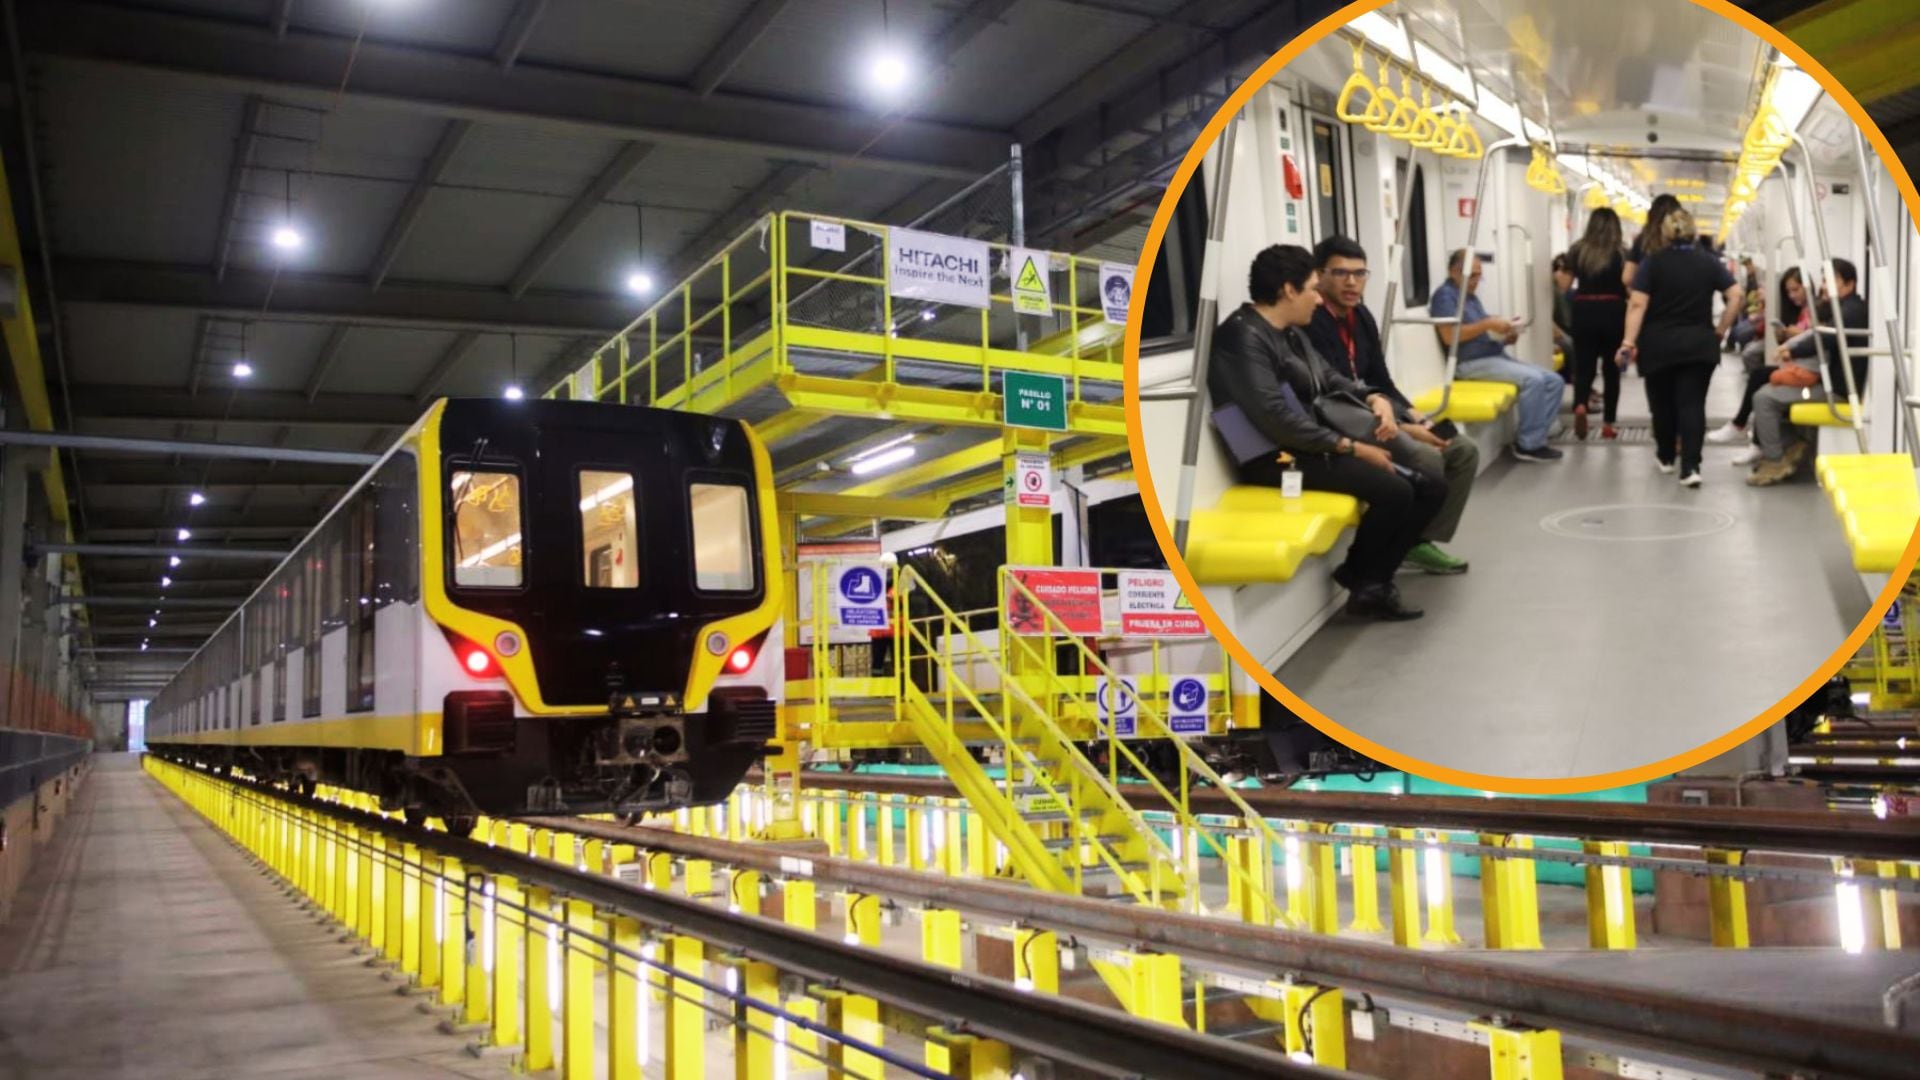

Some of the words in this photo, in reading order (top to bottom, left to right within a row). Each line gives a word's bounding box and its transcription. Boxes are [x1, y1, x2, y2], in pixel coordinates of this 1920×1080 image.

[899, 247, 979, 275] HITACHI
[894, 264, 934, 280] Inspire
[936, 271, 956, 284] the
[957, 273, 984, 289] Next
[1018, 387, 1052, 400] PASILLO
[1036, 400, 1051, 412] 01
[1127, 578, 1165, 588] PELIGRO
[1035, 584, 1066, 594] CUIDADO
[1067, 585, 1098, 595] PELIGRO
[1127, 590, 1165, 599] CORRIENTE
[1174, 619, 1201, 629] CURSO
